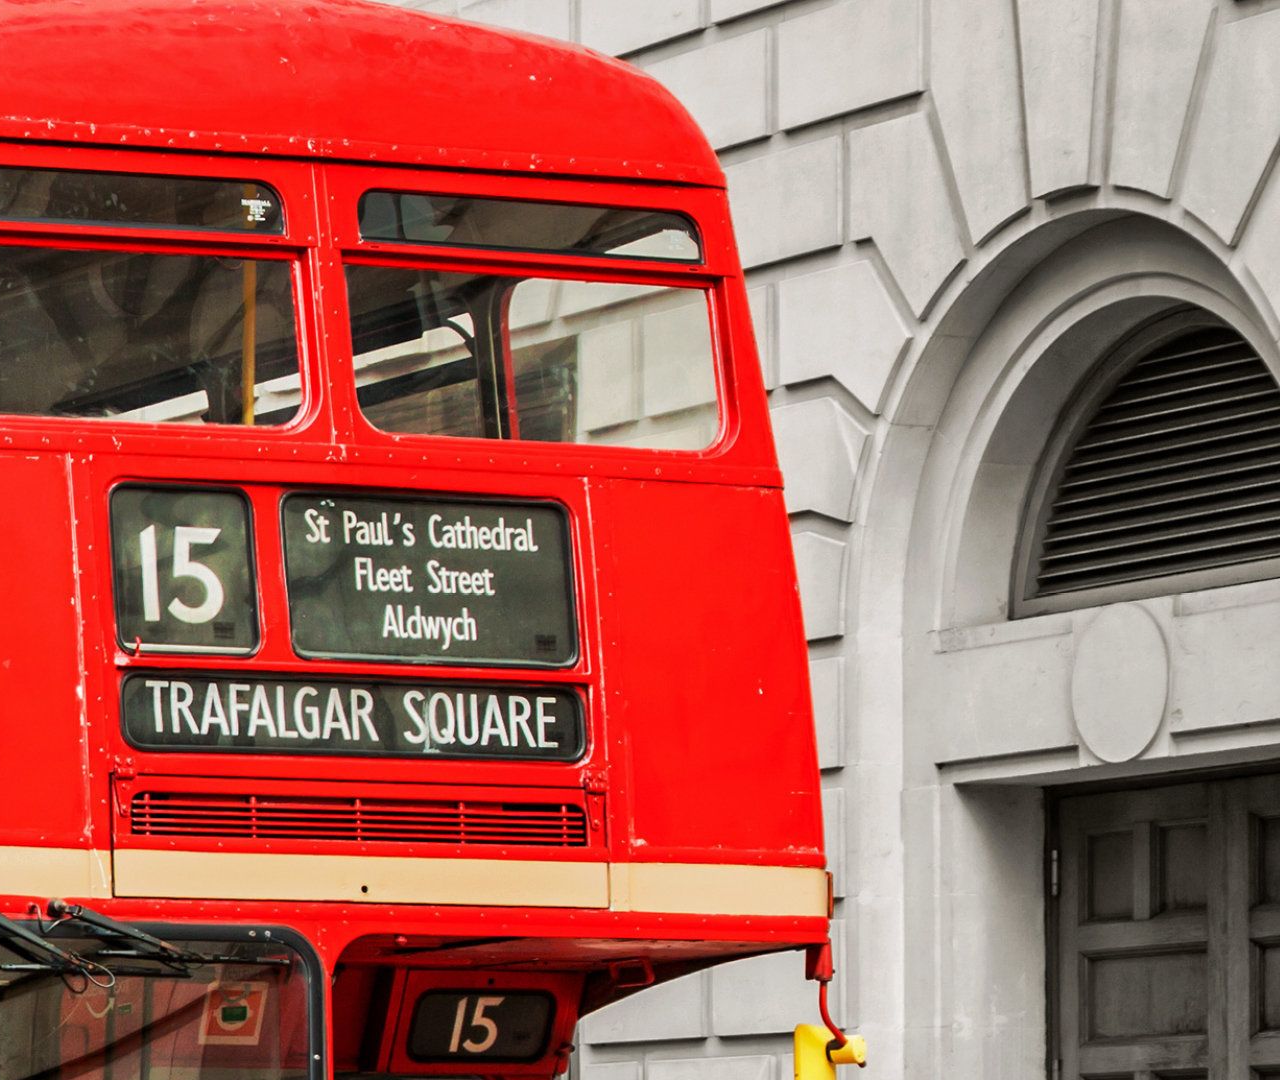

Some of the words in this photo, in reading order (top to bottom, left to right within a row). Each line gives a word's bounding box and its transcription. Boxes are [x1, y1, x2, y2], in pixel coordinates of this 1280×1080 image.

[304, 508, 331, 545] St
[343, 510, 416, 546] Paul's
[428, 514, 539, 553] Cathedral
[139, 523, 224, 624] 15
[354, 557, 414, 594] Fleet
[428, 559, 496, 597] Street
[382, 603, 478, 650] Aldwych
[145, 680, 380, 742] TRAFALGAR
[403, 689, 560, 749] SQUARE
[448, 996, 506, 1053] 15
